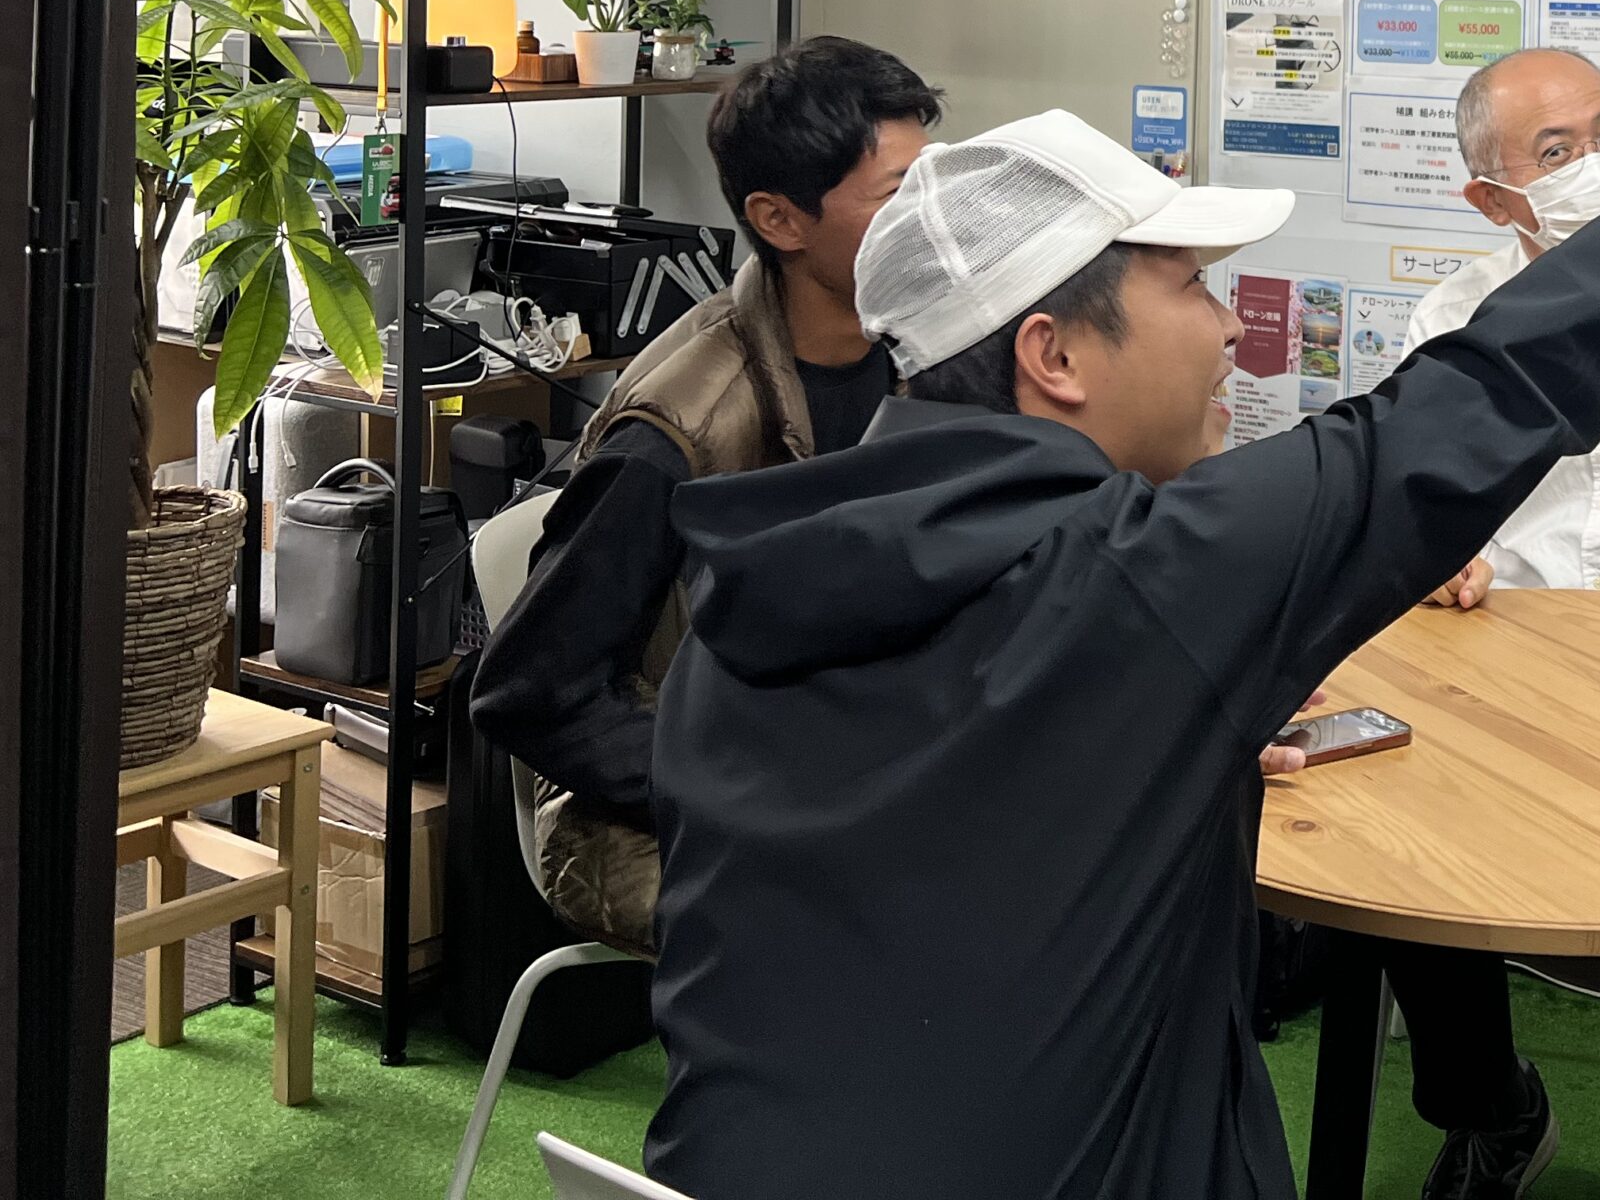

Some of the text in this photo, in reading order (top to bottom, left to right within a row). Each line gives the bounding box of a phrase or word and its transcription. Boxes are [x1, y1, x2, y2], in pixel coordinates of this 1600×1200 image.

[1377, 20, 1418, 32] ¥33,000
[1459, 23, 1500, 35] ¥55,000
[1396, 106, 1413, 117] 補講
[1403, 256, 1471, 274] サービス
